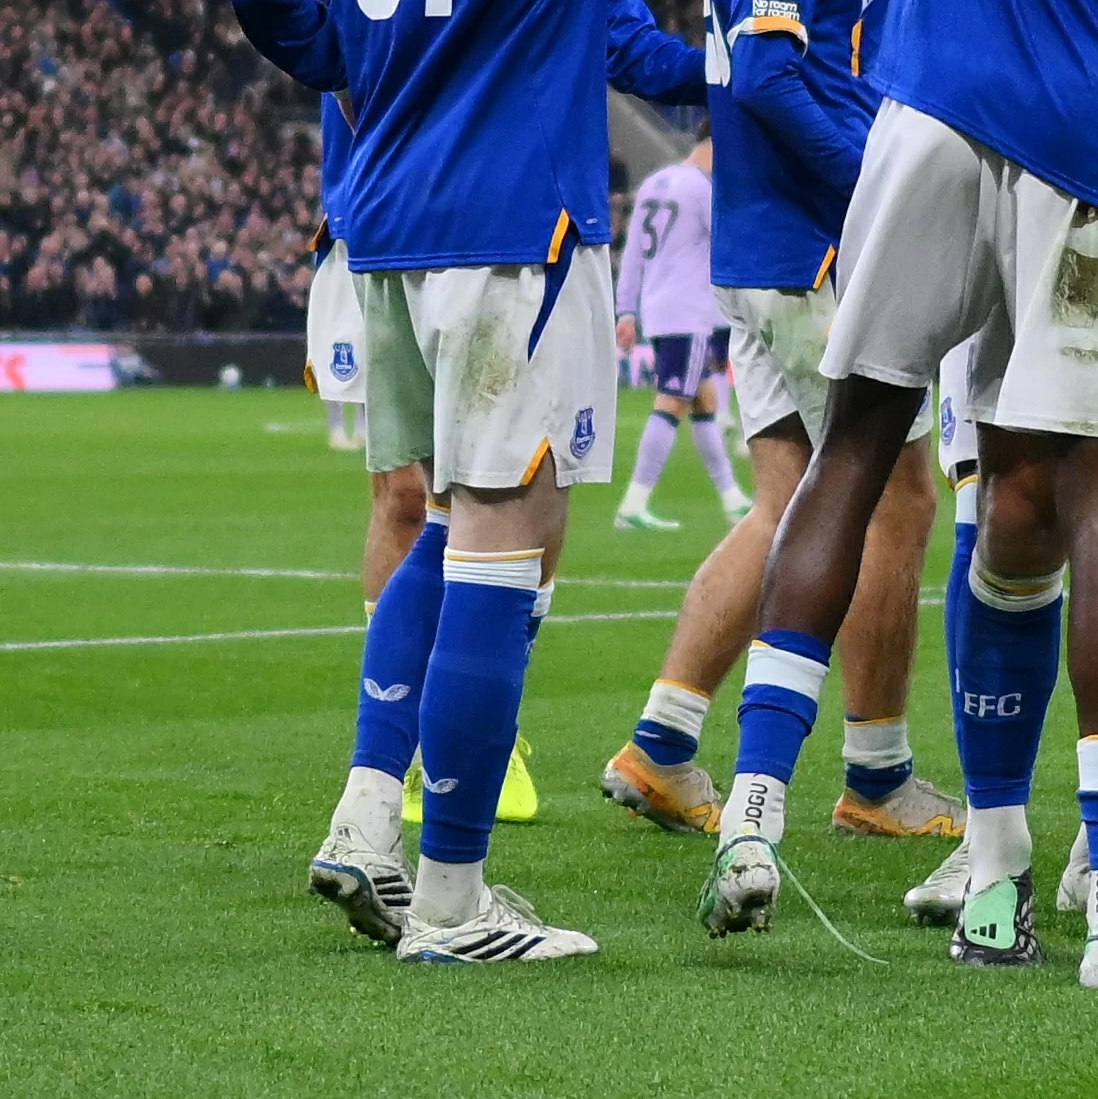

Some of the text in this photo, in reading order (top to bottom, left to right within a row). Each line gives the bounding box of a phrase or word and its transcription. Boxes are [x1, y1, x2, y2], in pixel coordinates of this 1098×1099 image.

[769, 0, 798, 12] room
[640, 198, 680, 261] 37
[963, 691, 1022, 718] EFC
